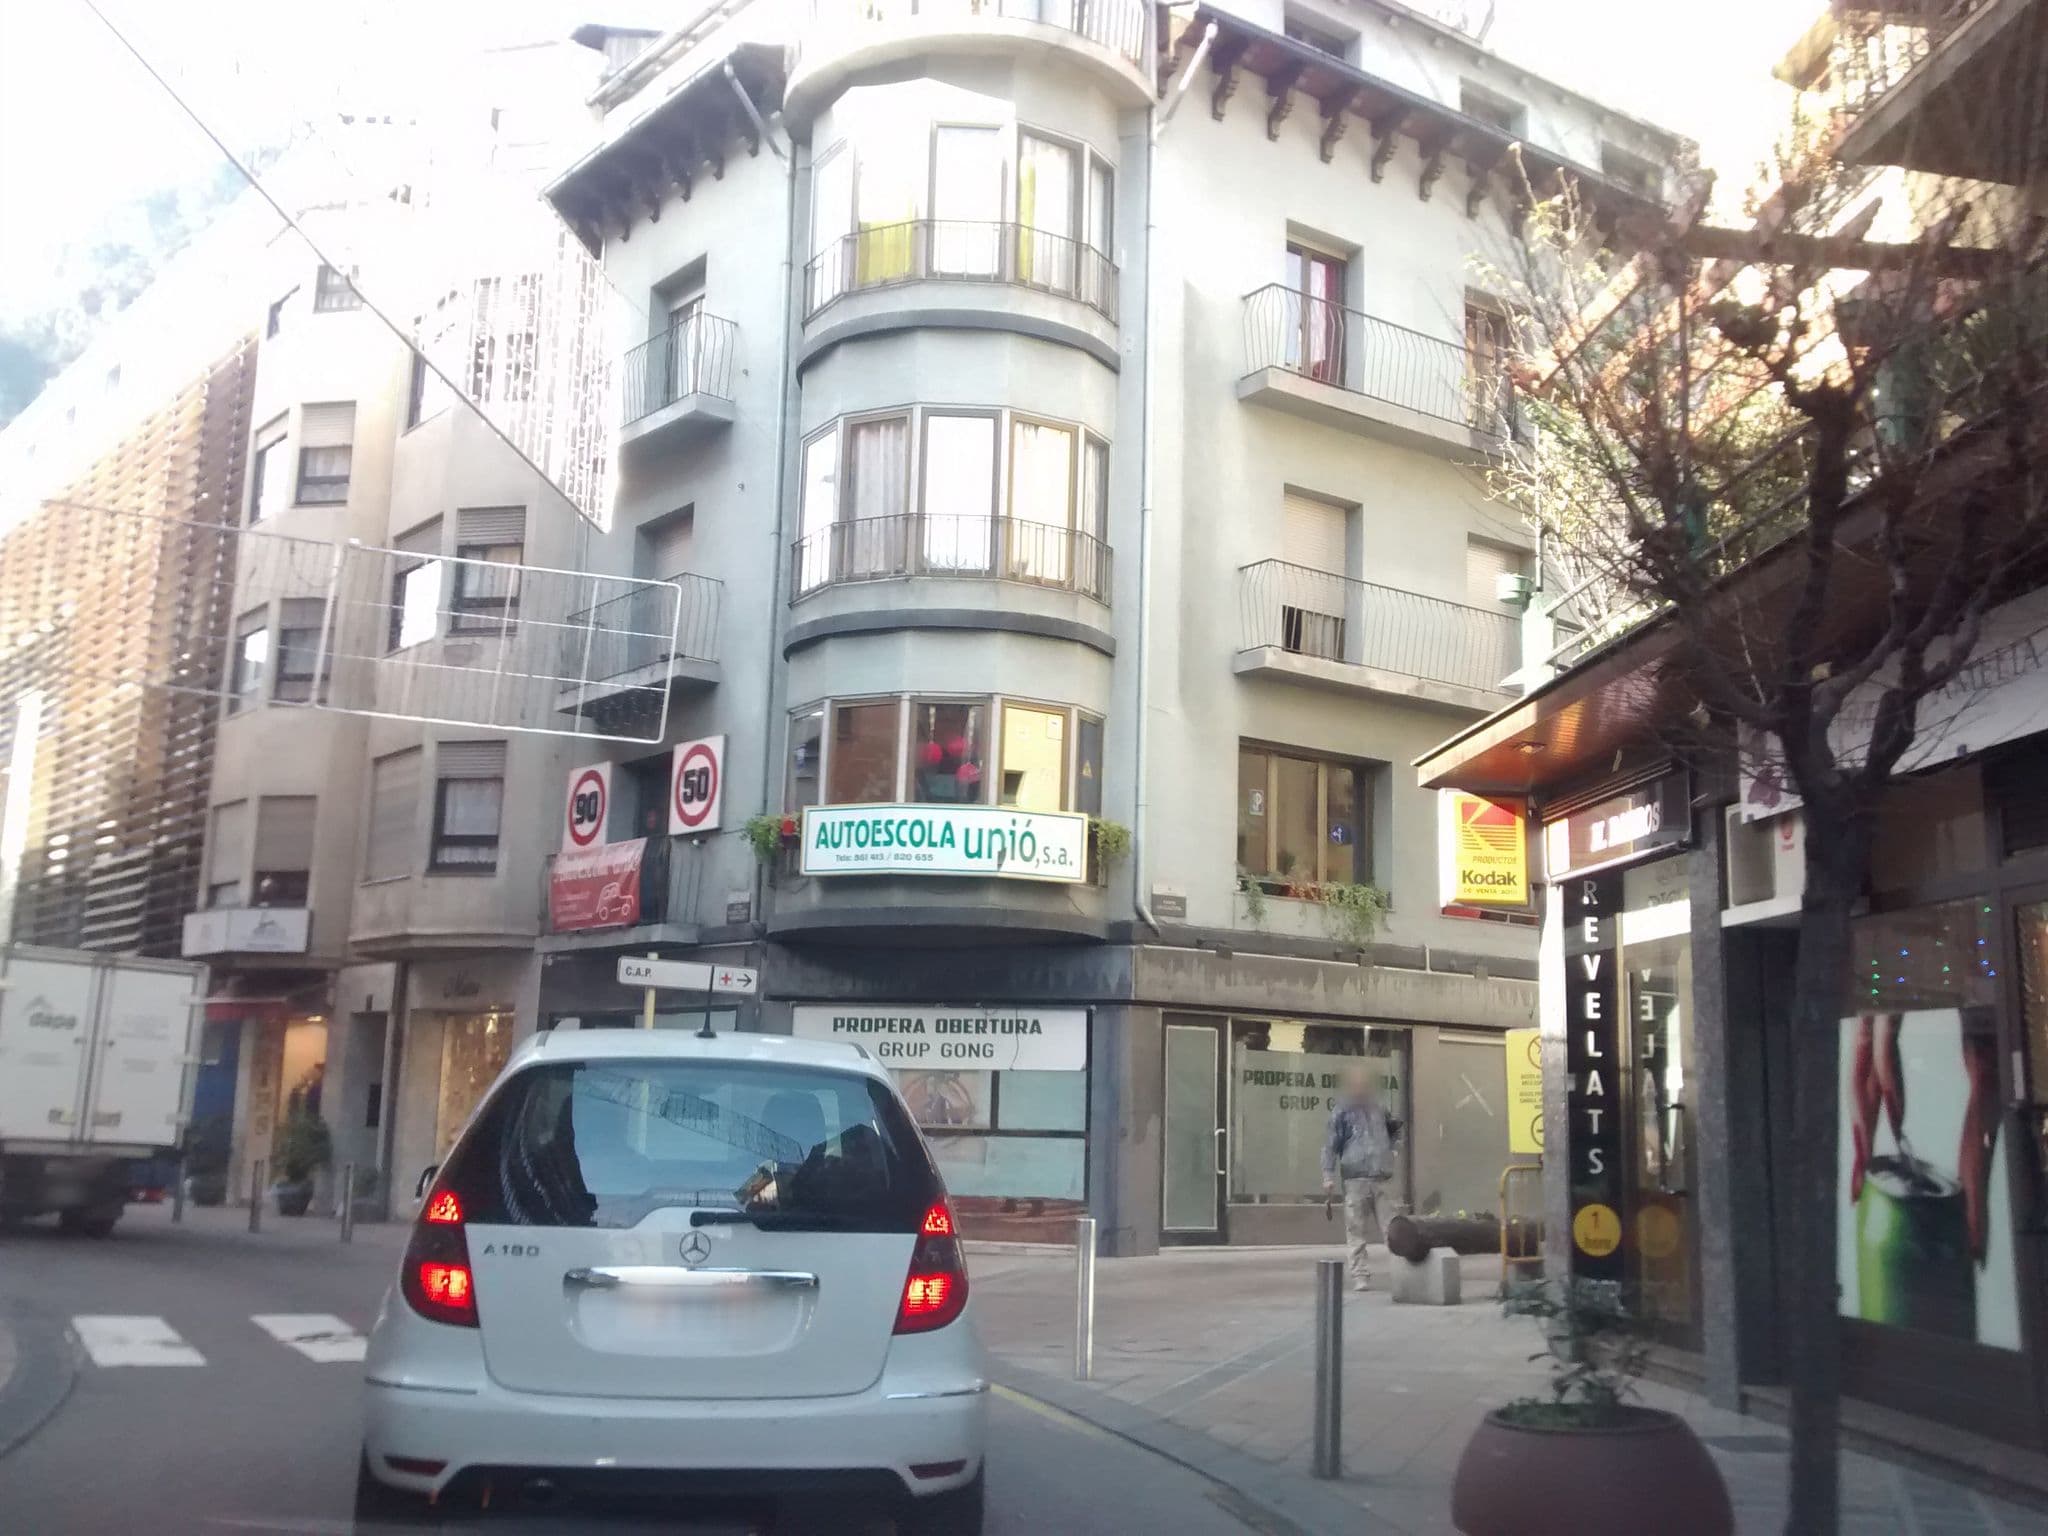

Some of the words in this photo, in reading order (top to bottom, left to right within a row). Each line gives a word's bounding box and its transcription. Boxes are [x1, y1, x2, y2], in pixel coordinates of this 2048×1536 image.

[683, 767, 709, 803] 50
[575, 791, 599, 825] 90
[815, 819, 955, 849] AUTOESCOLA
[1462, 869, 1518, 886] Kodak
[832, 1016, 926, 1034] PROPERA
[935, 1017, 1043, 1035] OBERTURA
[1583, 880, 1604, 1175] REVELATS
[878, 1041, 931, 1057] GRUP
[940, 1042, 995, 1058] GONG
[1243, 1070, 1316, 1088] PROPERA
[1279, 1095, 1320, 1111] GRUP
[502, 1245, 540, 1257] 180
